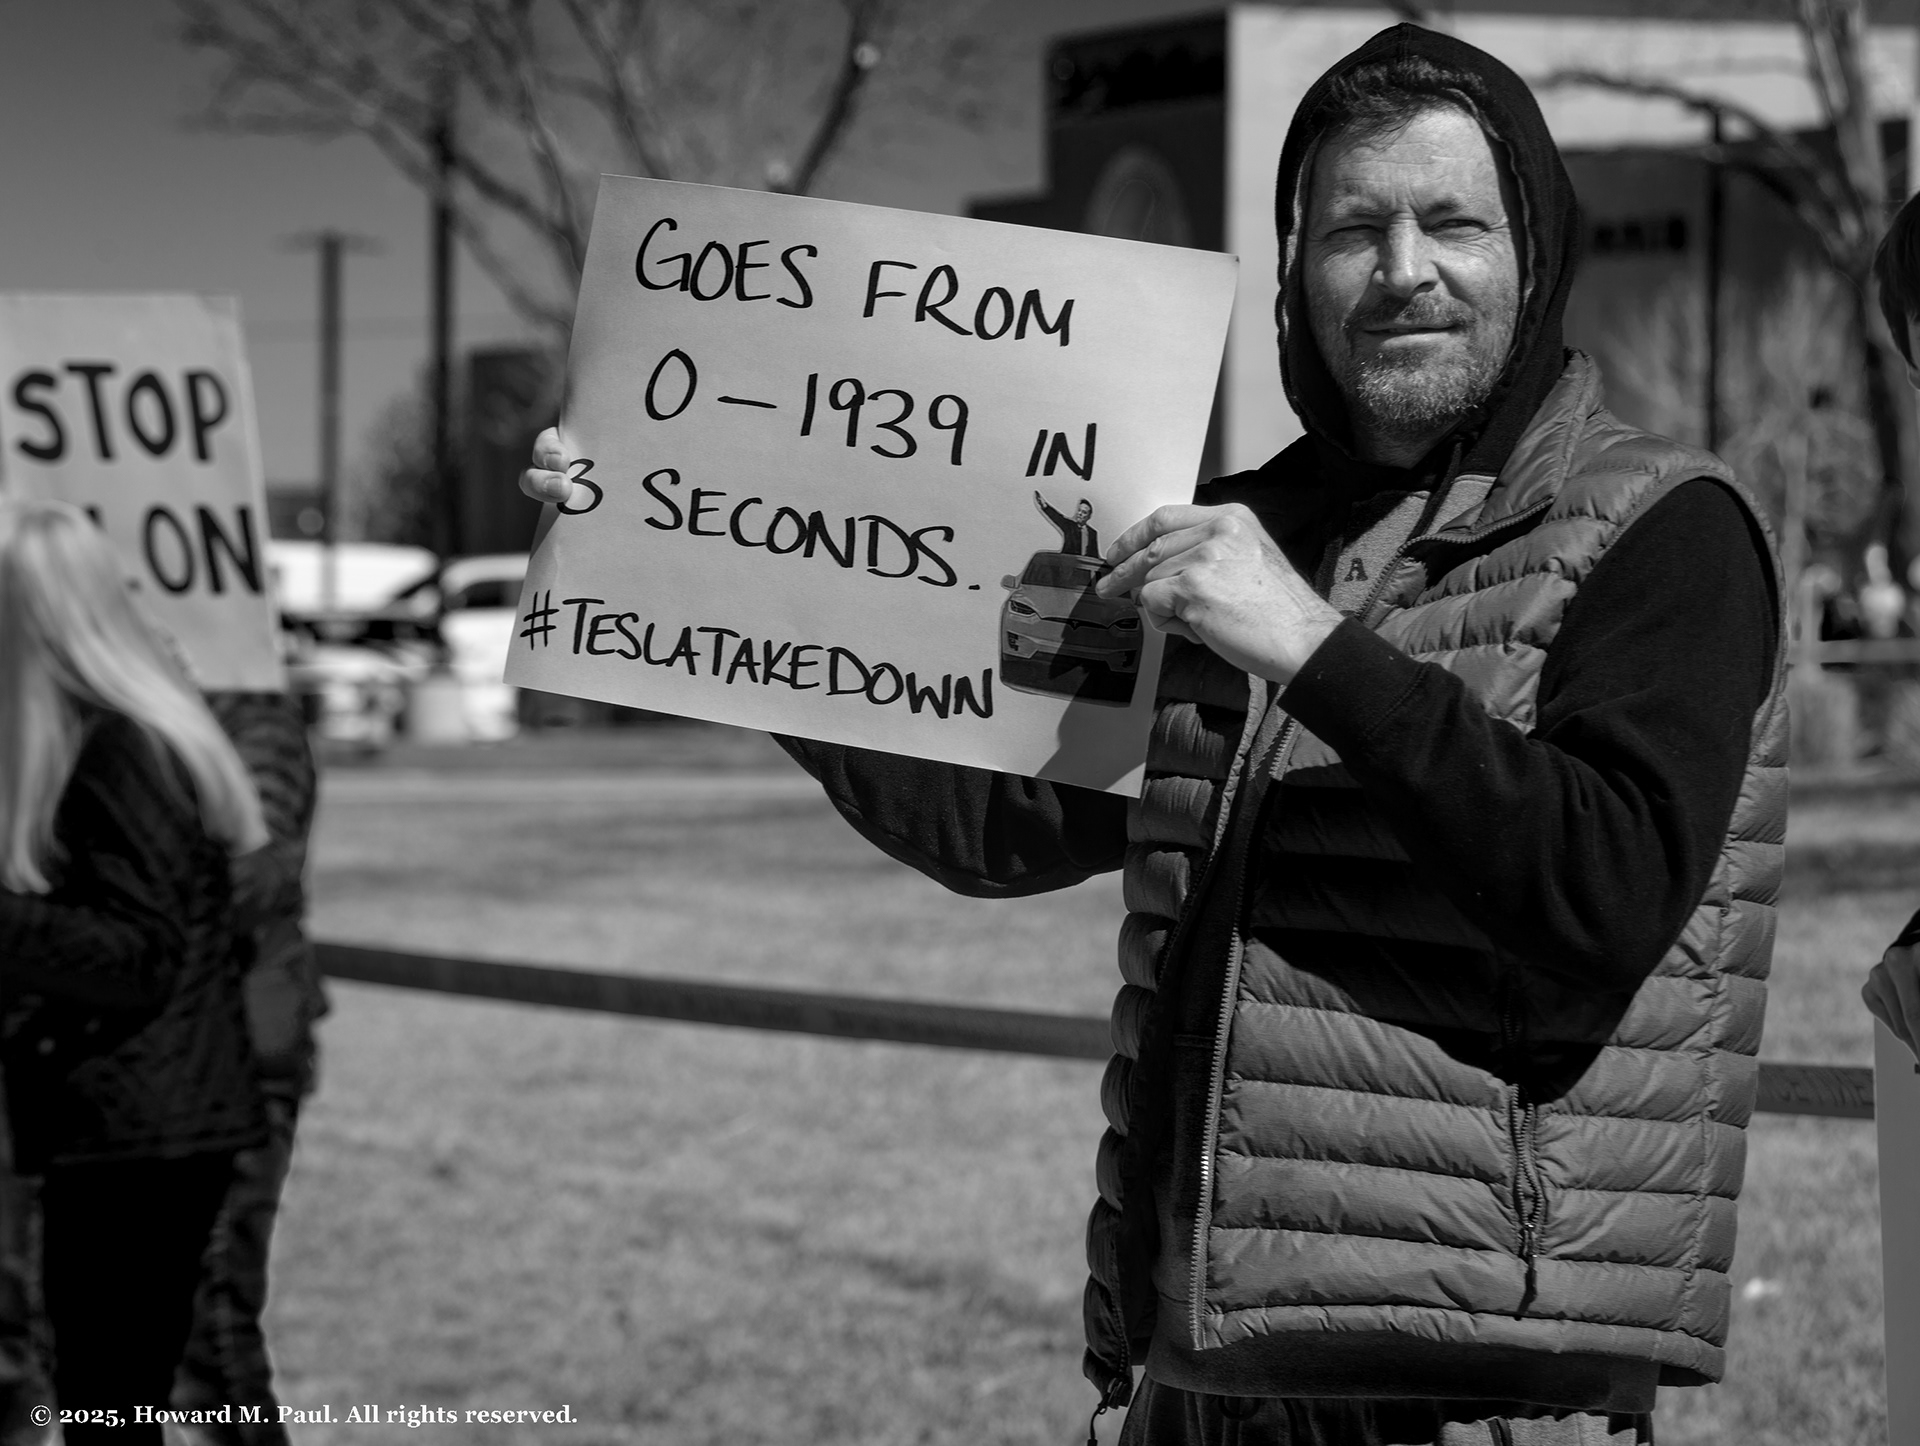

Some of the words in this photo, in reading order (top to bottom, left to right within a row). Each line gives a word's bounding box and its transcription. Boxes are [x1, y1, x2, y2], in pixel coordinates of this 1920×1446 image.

[635, 217, 818, 309] GOES
[863, 260, 1075, 347] FROM
[12, 359, 230, 464] STOP
[1025, 422, 1097, 481] IN
[86, 504, 265, 596] ON
[556, 458, 604, 516] 3
[642, 468, 981, 591] SECONDS.
[1343, 557, 1369, 582] A
[519, 589, 994, 720] #TESLATAKEDOWN
